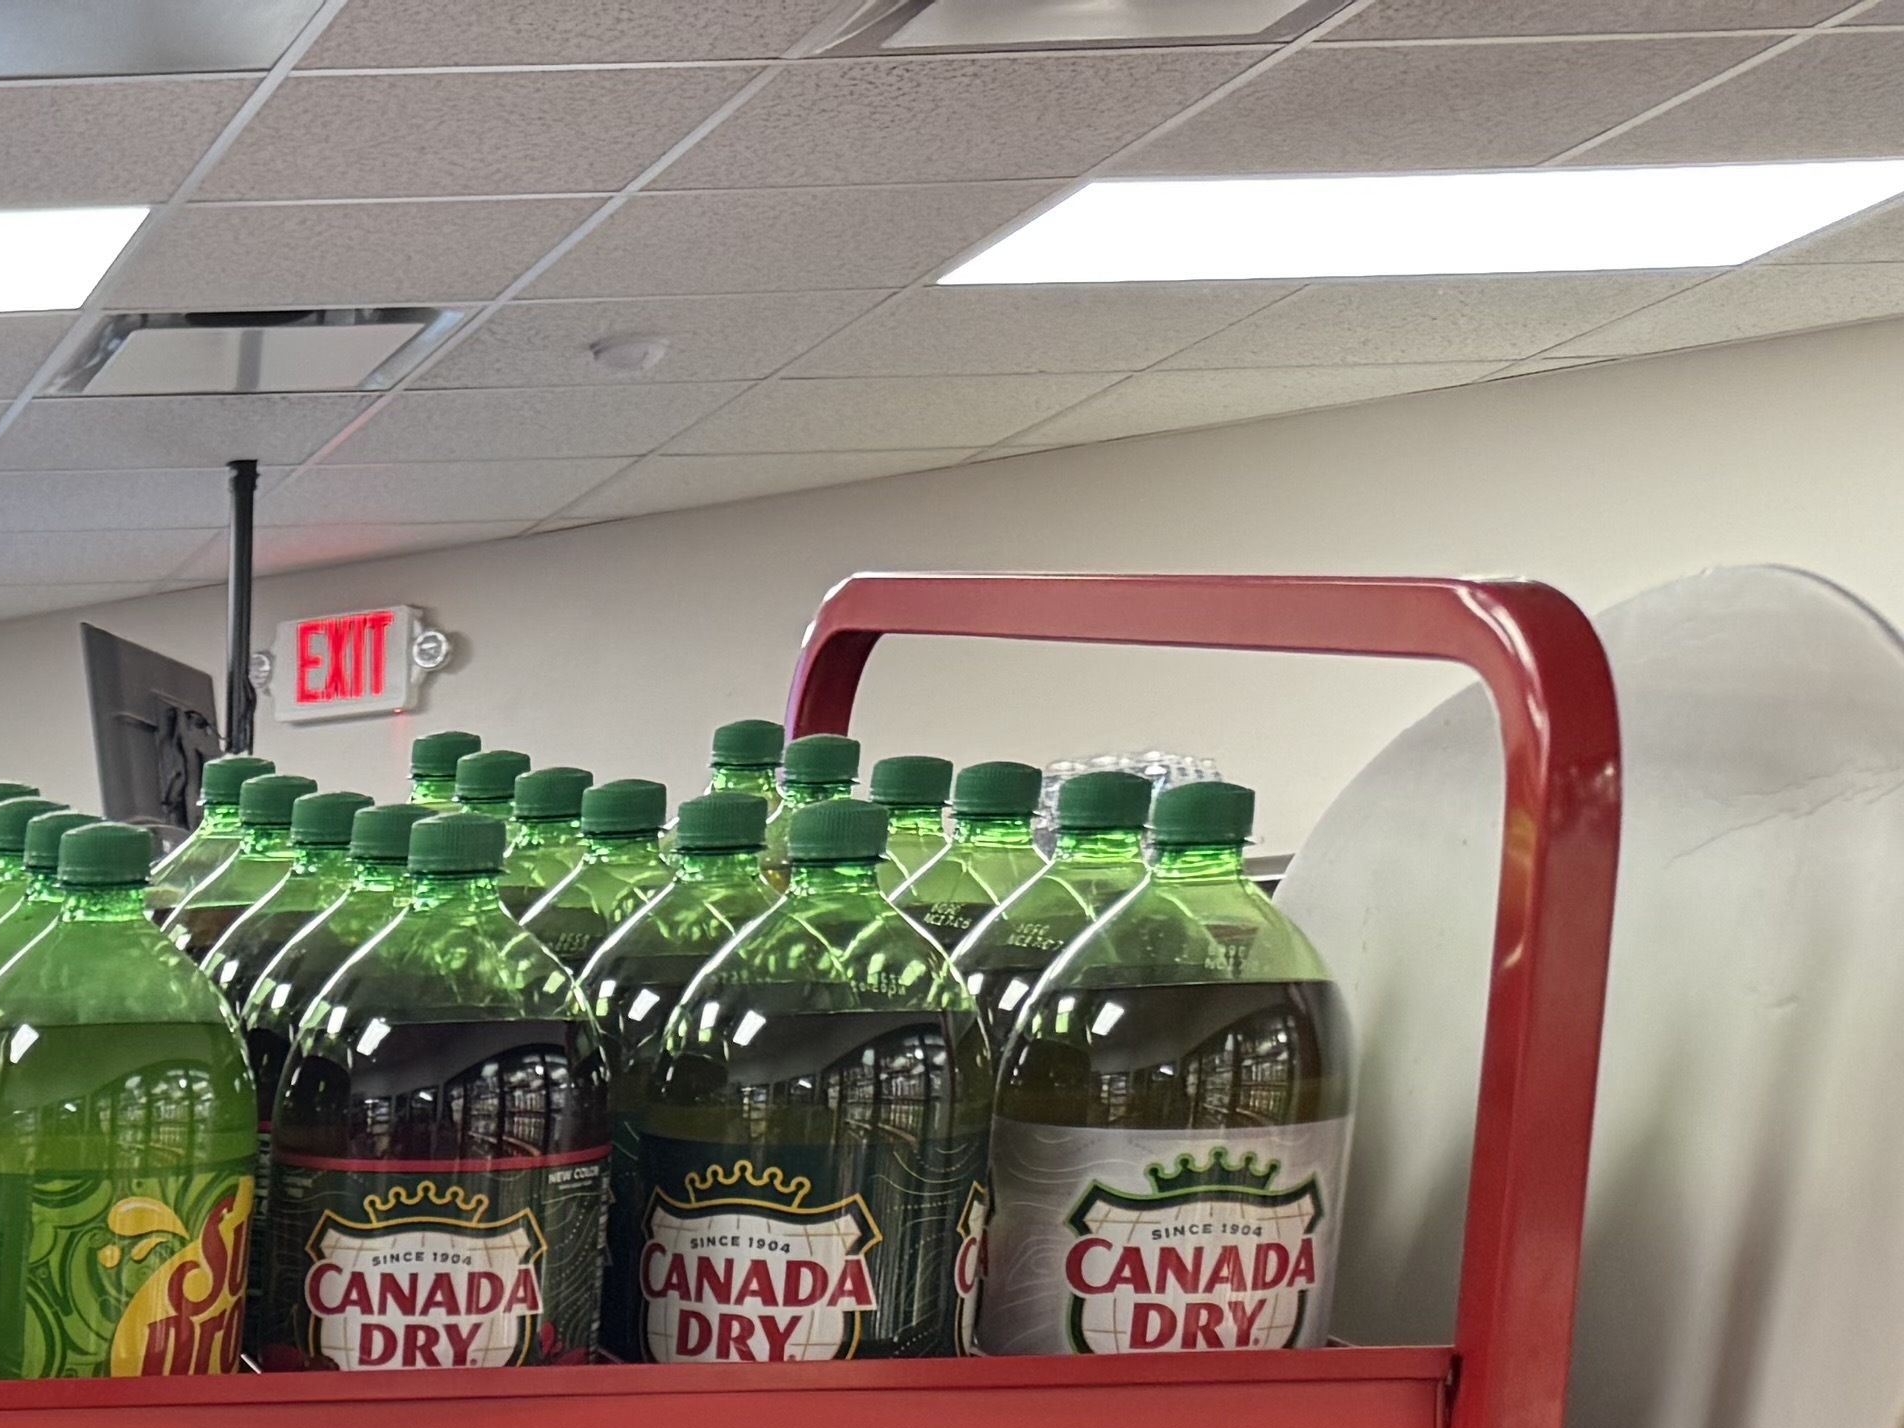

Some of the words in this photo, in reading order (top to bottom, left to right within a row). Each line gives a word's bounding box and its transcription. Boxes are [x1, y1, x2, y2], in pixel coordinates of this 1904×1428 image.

[297, 611, 391, 702] EXIT
[689, 1235, 741, 1253] SINCE
[745, 1237, 791, 1256] 1904
[1150, 1221, 1213, 1241] SINCE
[1218, 1220, 1264, 1239] 1904
[372, 1251, 425, 1267] SINCE
[432, 1251, 474, 1267] 1904
[640, 1242, 877, 1309] CANADA
[1064, 1236, 1319, 1297] CANADA
[308, 1263, 541, 1316] CANADA
[358, 1321, 485, 1368] DRY
[675, 1310, 798, 1362] DRY
[1128, 1300, 1262, 1352] DRY
